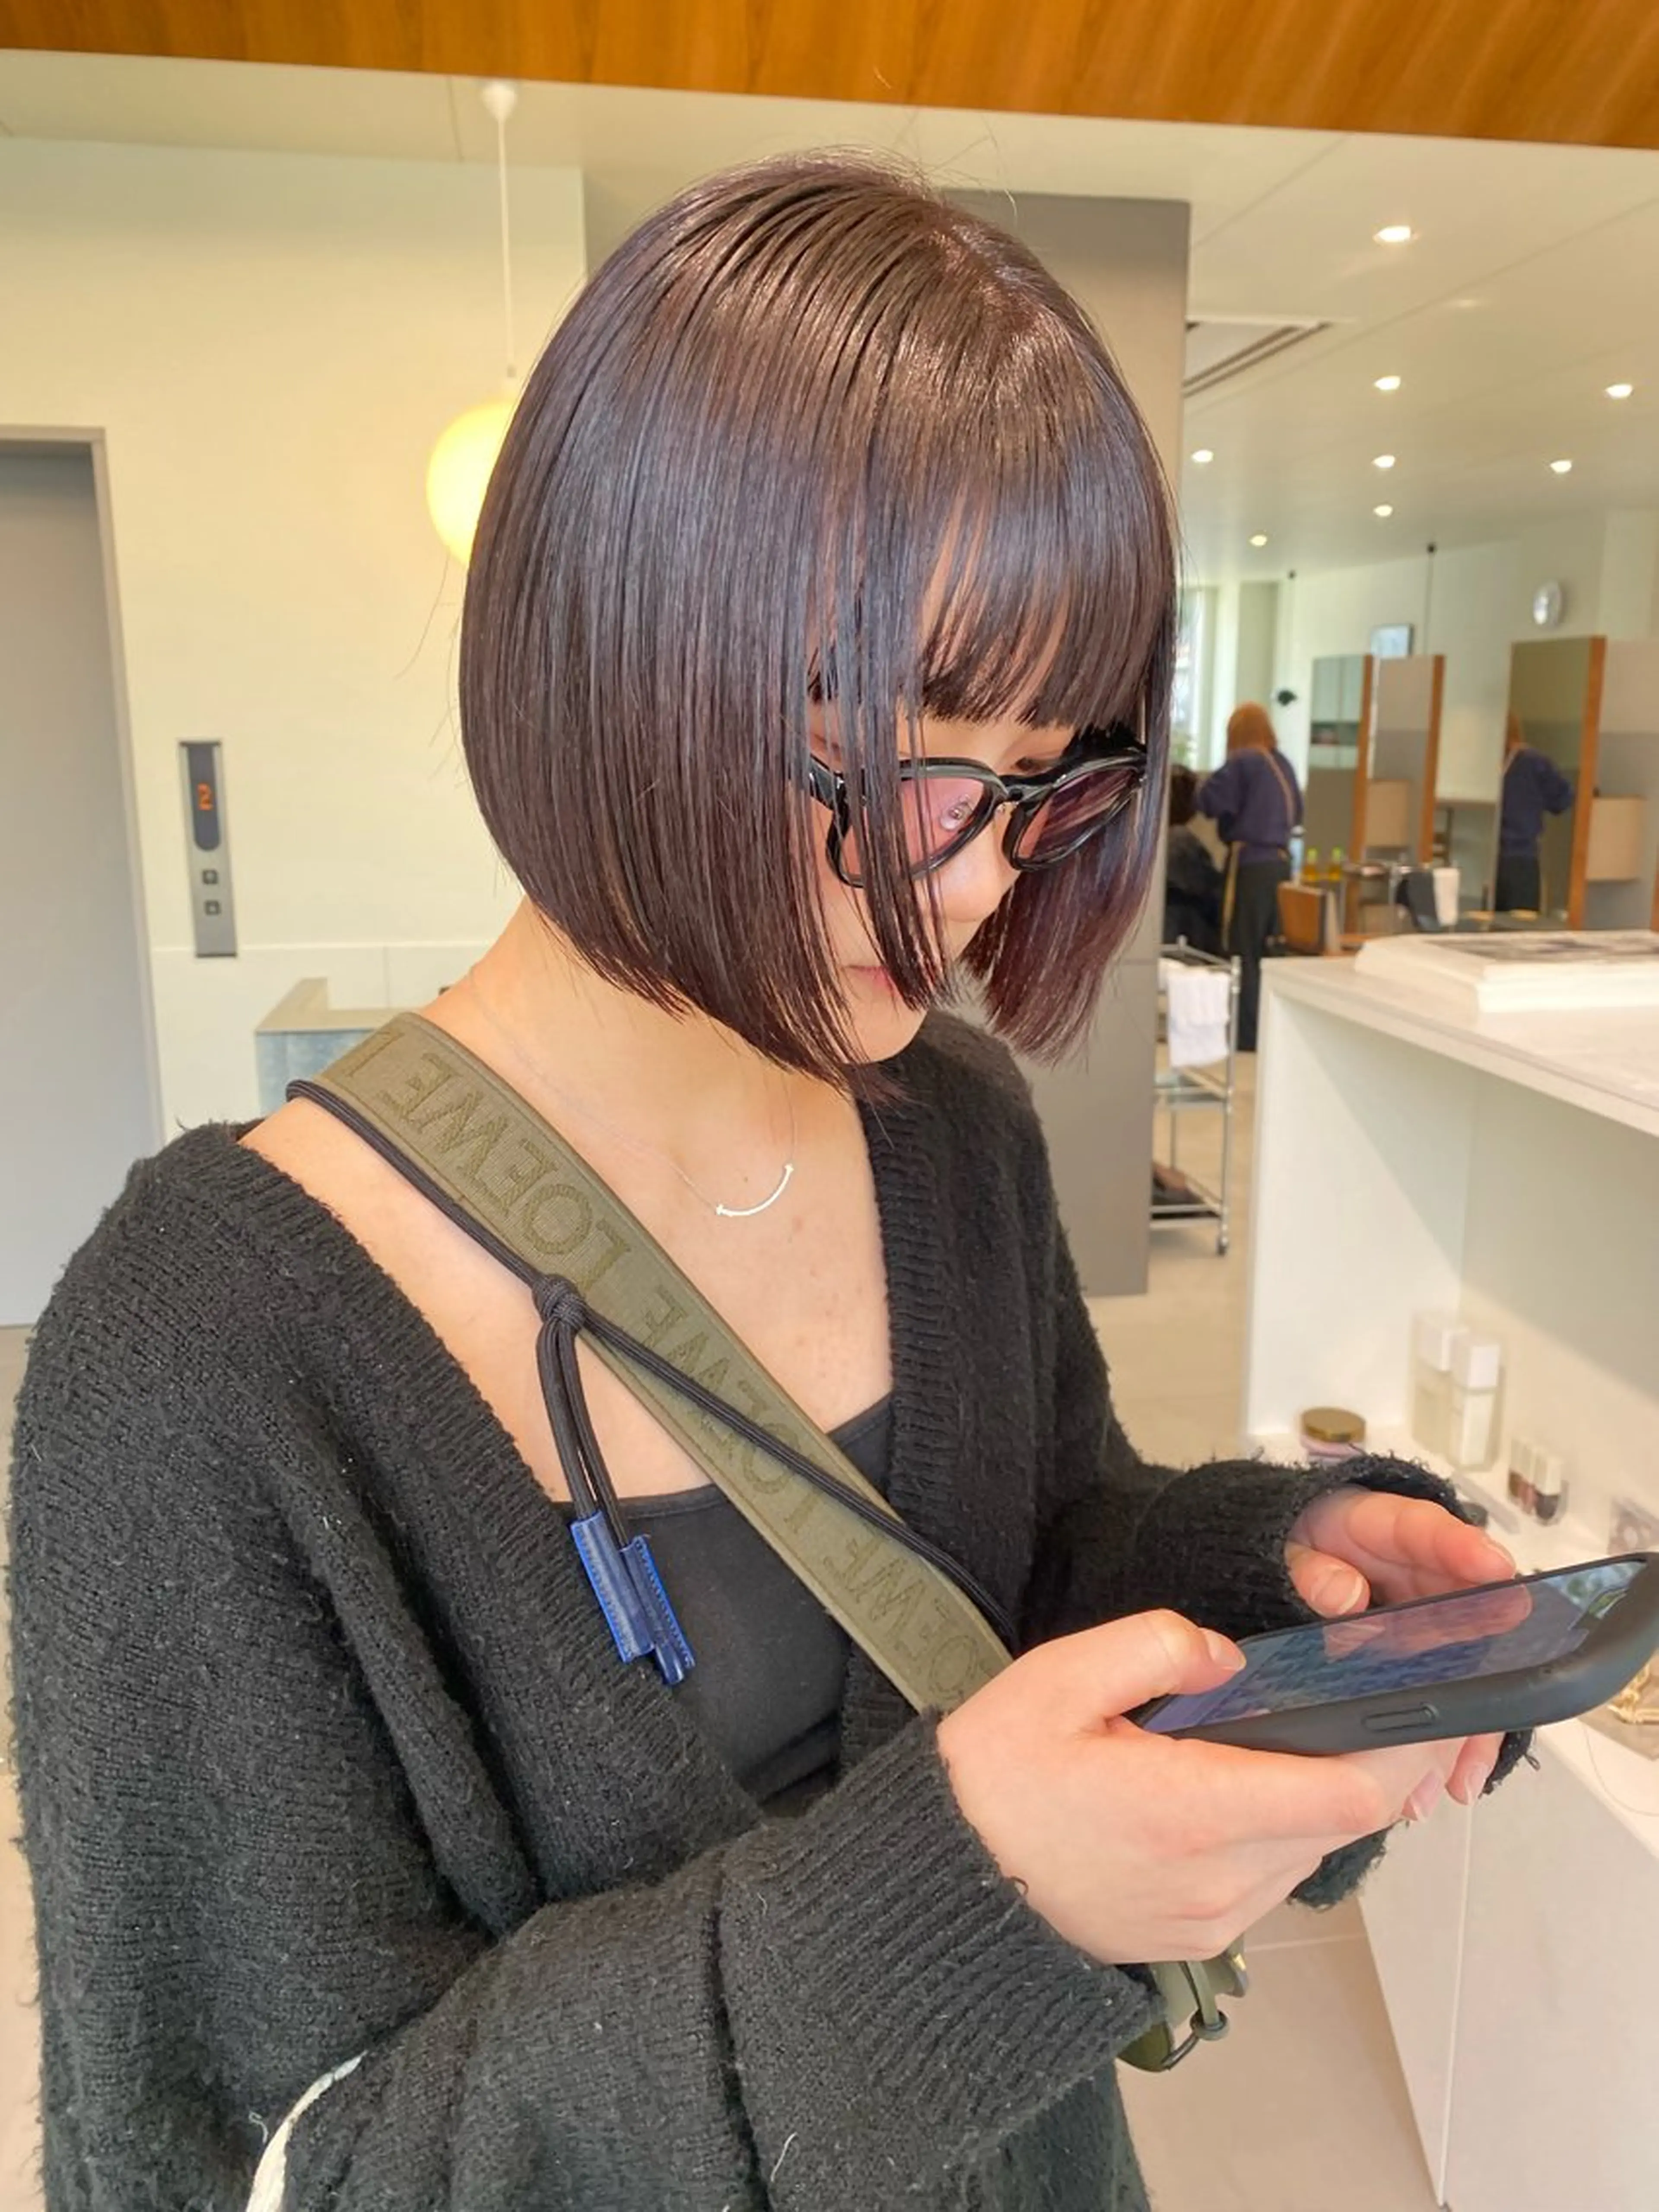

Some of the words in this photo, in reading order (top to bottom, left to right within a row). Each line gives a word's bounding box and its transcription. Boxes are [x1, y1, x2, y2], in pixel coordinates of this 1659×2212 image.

[197, 782, 213, 811] 2
[376, 1052, 632, 1291] LOEWE
[822, 1537, 993, 1704] OEWE
